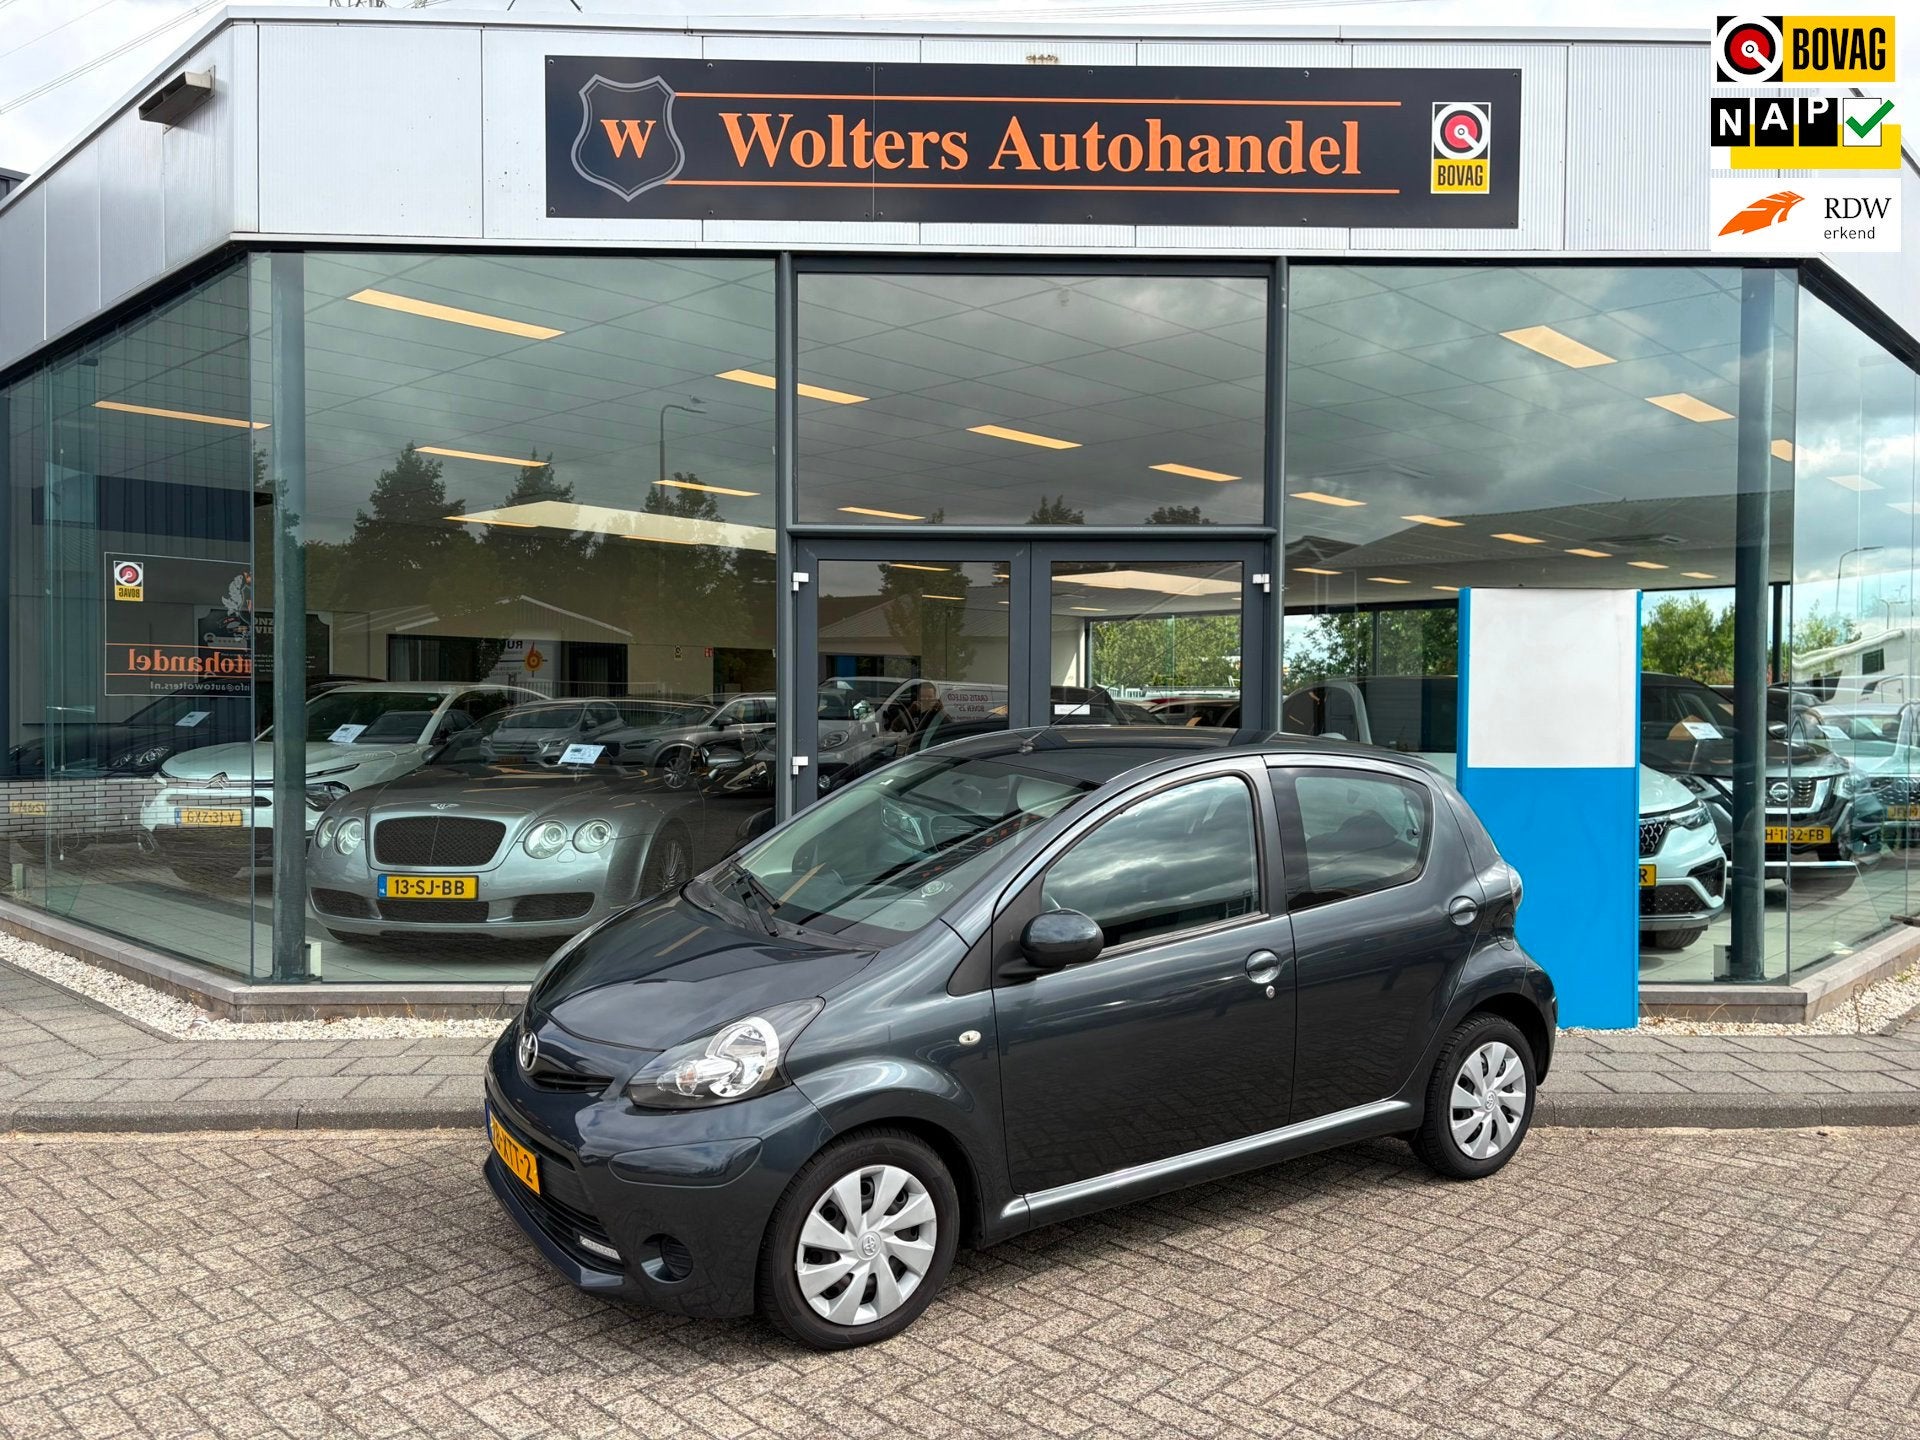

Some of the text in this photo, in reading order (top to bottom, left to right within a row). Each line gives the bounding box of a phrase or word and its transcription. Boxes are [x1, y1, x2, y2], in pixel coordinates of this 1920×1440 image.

[600, 118, 657, 159] W
[718, 112, 1362, 176] Wolters Autohandel
[1437, 164, 1484, 187] BOVAG
[395, 879, 465, 896] 13-SJ-BB
